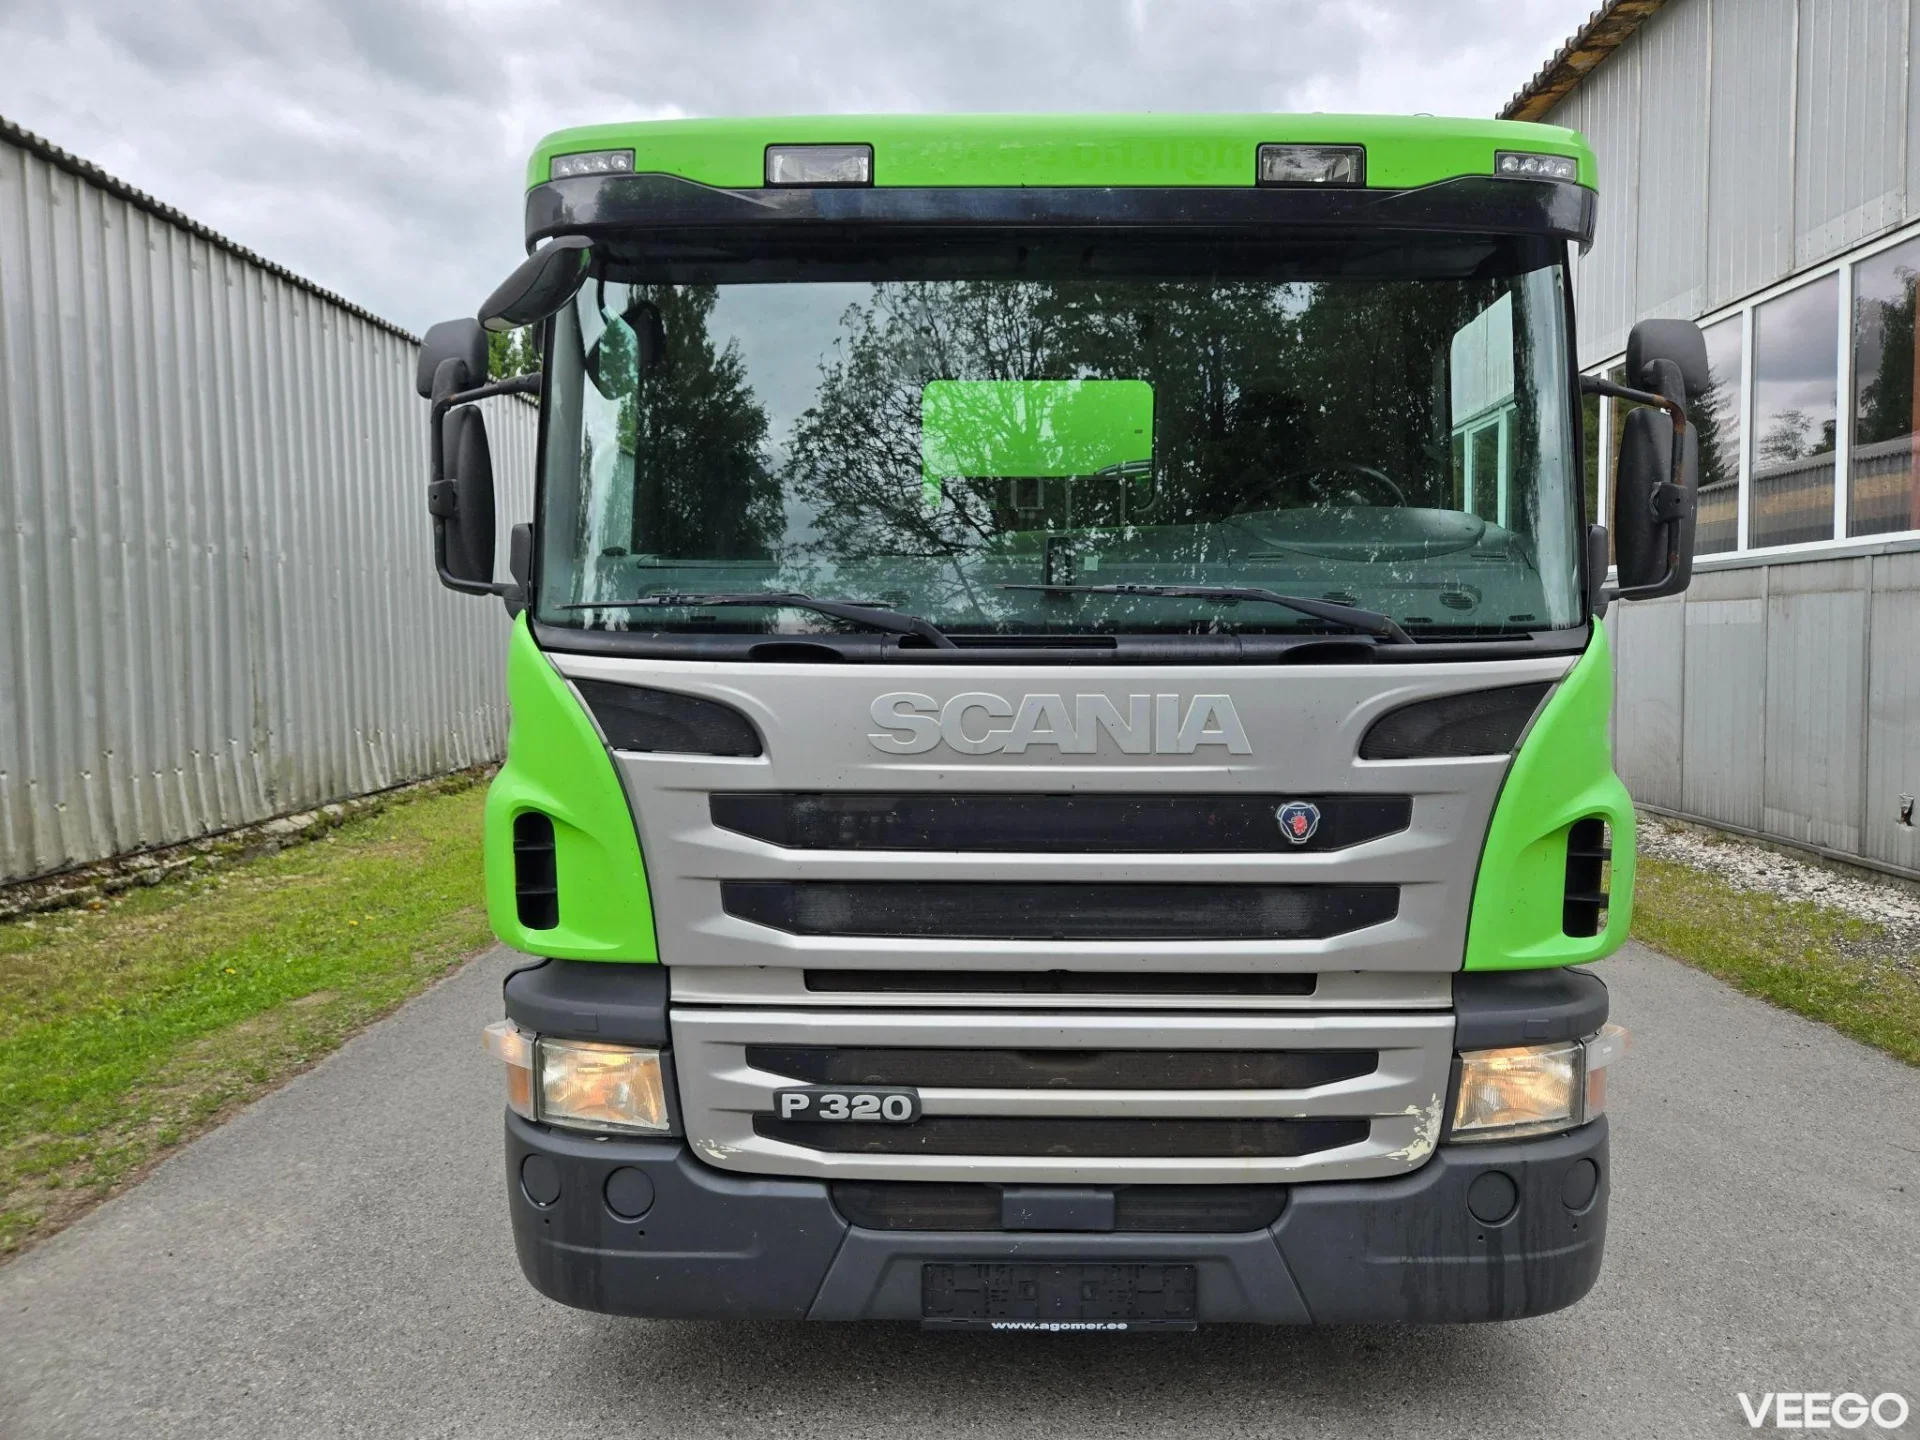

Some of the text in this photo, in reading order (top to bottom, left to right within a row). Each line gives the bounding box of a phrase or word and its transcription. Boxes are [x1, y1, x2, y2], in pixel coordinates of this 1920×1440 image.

[867, 692, 1253, 755] SCANIA
[781, 1093, 913, 1120] P 320
[991, 1322, 1128, 1331] www.agomer.ee
